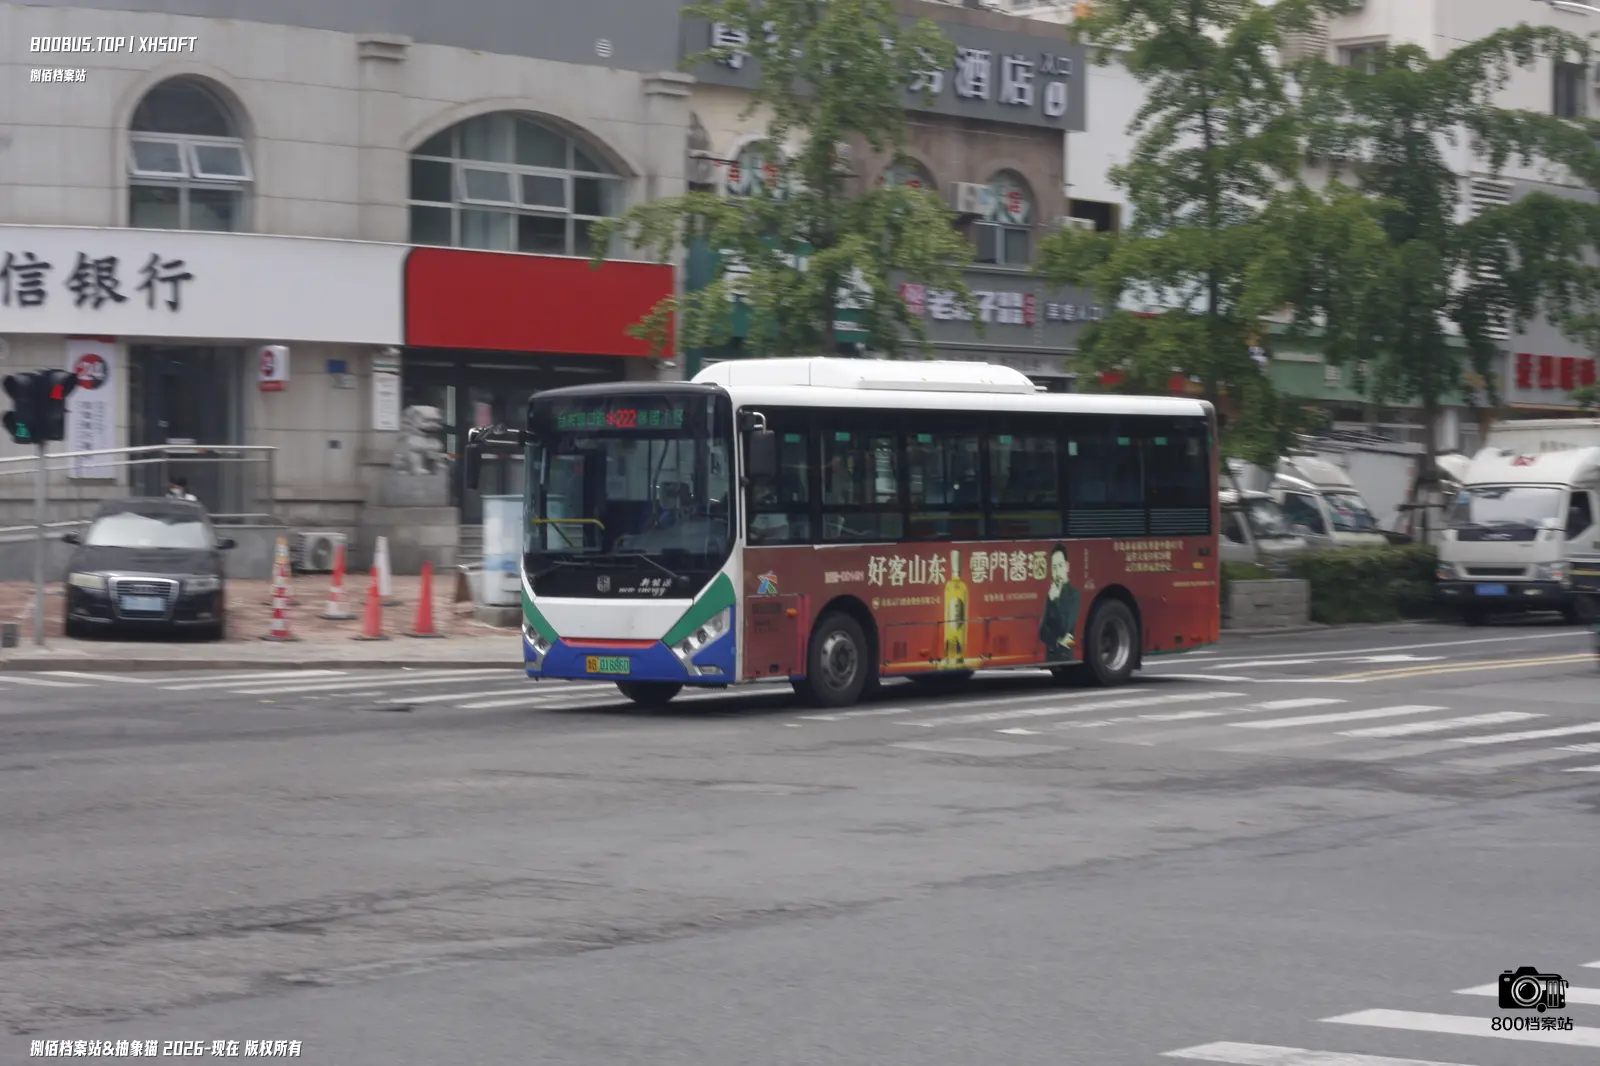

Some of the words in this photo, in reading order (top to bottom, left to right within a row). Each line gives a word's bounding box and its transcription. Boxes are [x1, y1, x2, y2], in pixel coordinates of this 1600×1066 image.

[0, 250, 194, 312] 信银行
[868, 553, 946, 587] 好客山东
